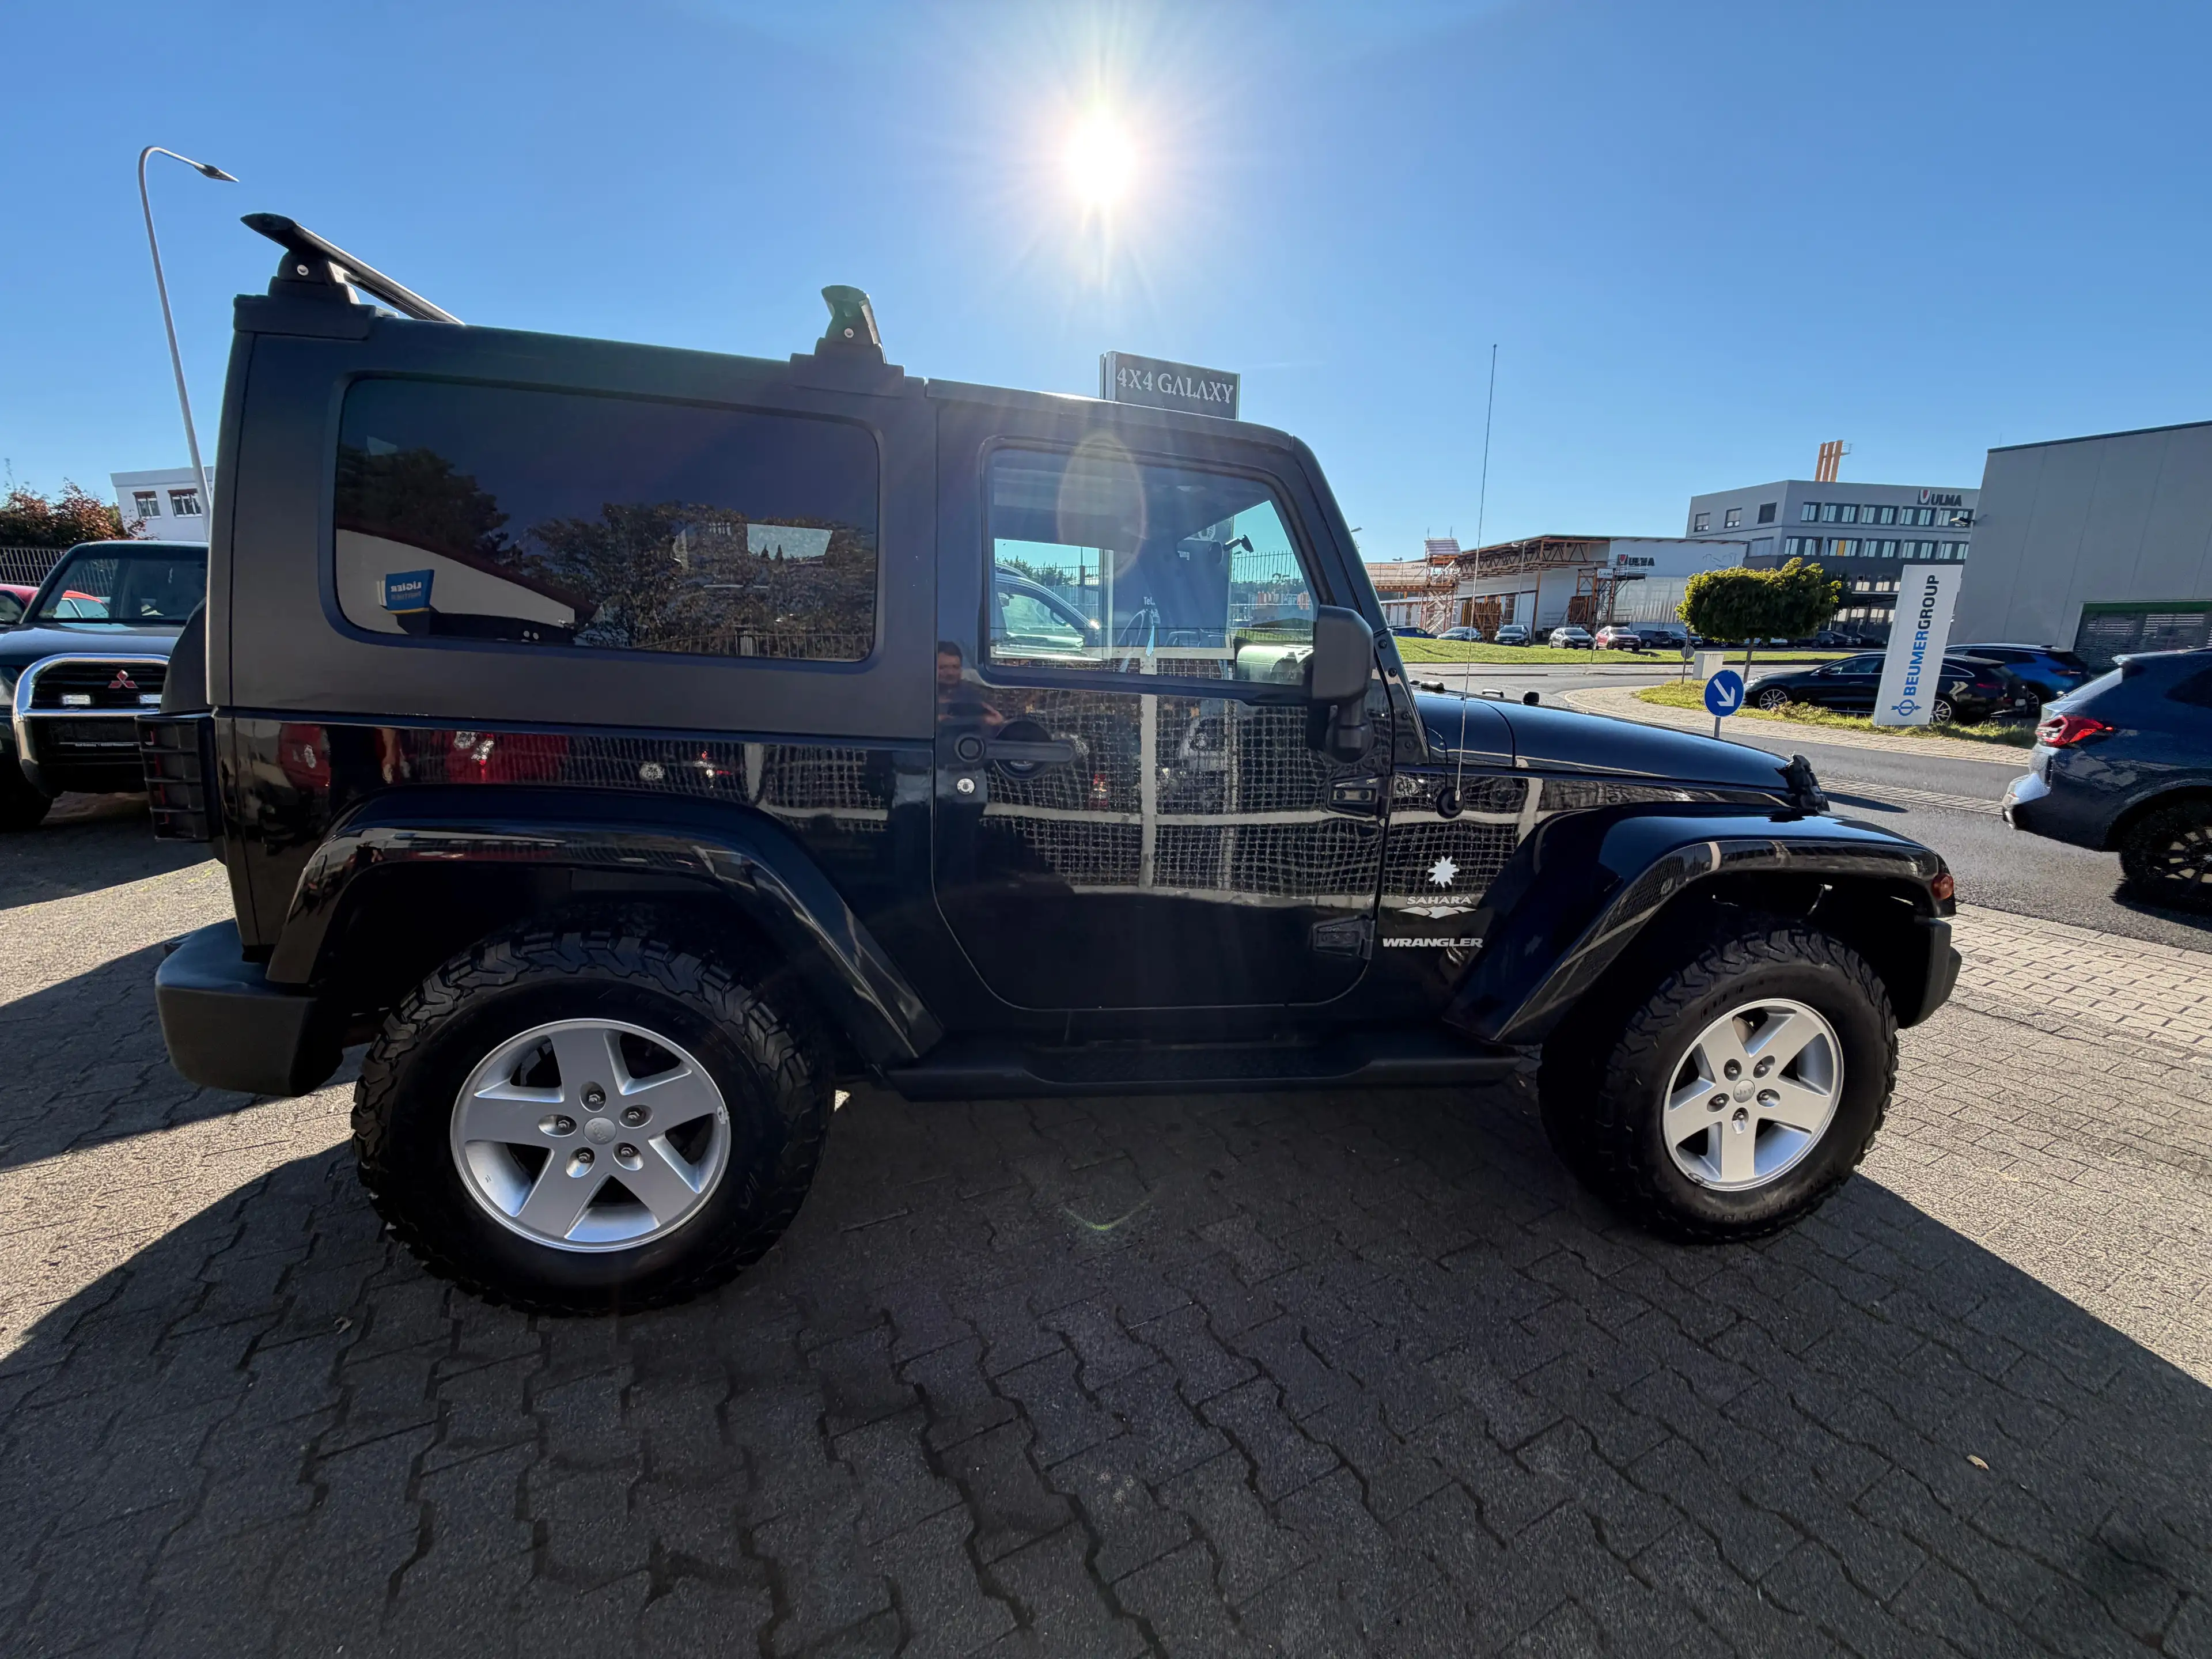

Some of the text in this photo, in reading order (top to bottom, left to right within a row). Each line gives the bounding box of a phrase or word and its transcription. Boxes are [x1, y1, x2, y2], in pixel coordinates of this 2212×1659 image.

[1116, 366, 1234, 404] 4X4 GALAXY
[1931, 493, 1962, 506] ULMA
[1406, 895, 1472, 905] SAHARA
[1382, 937, 1483, 948] WRANGLER
